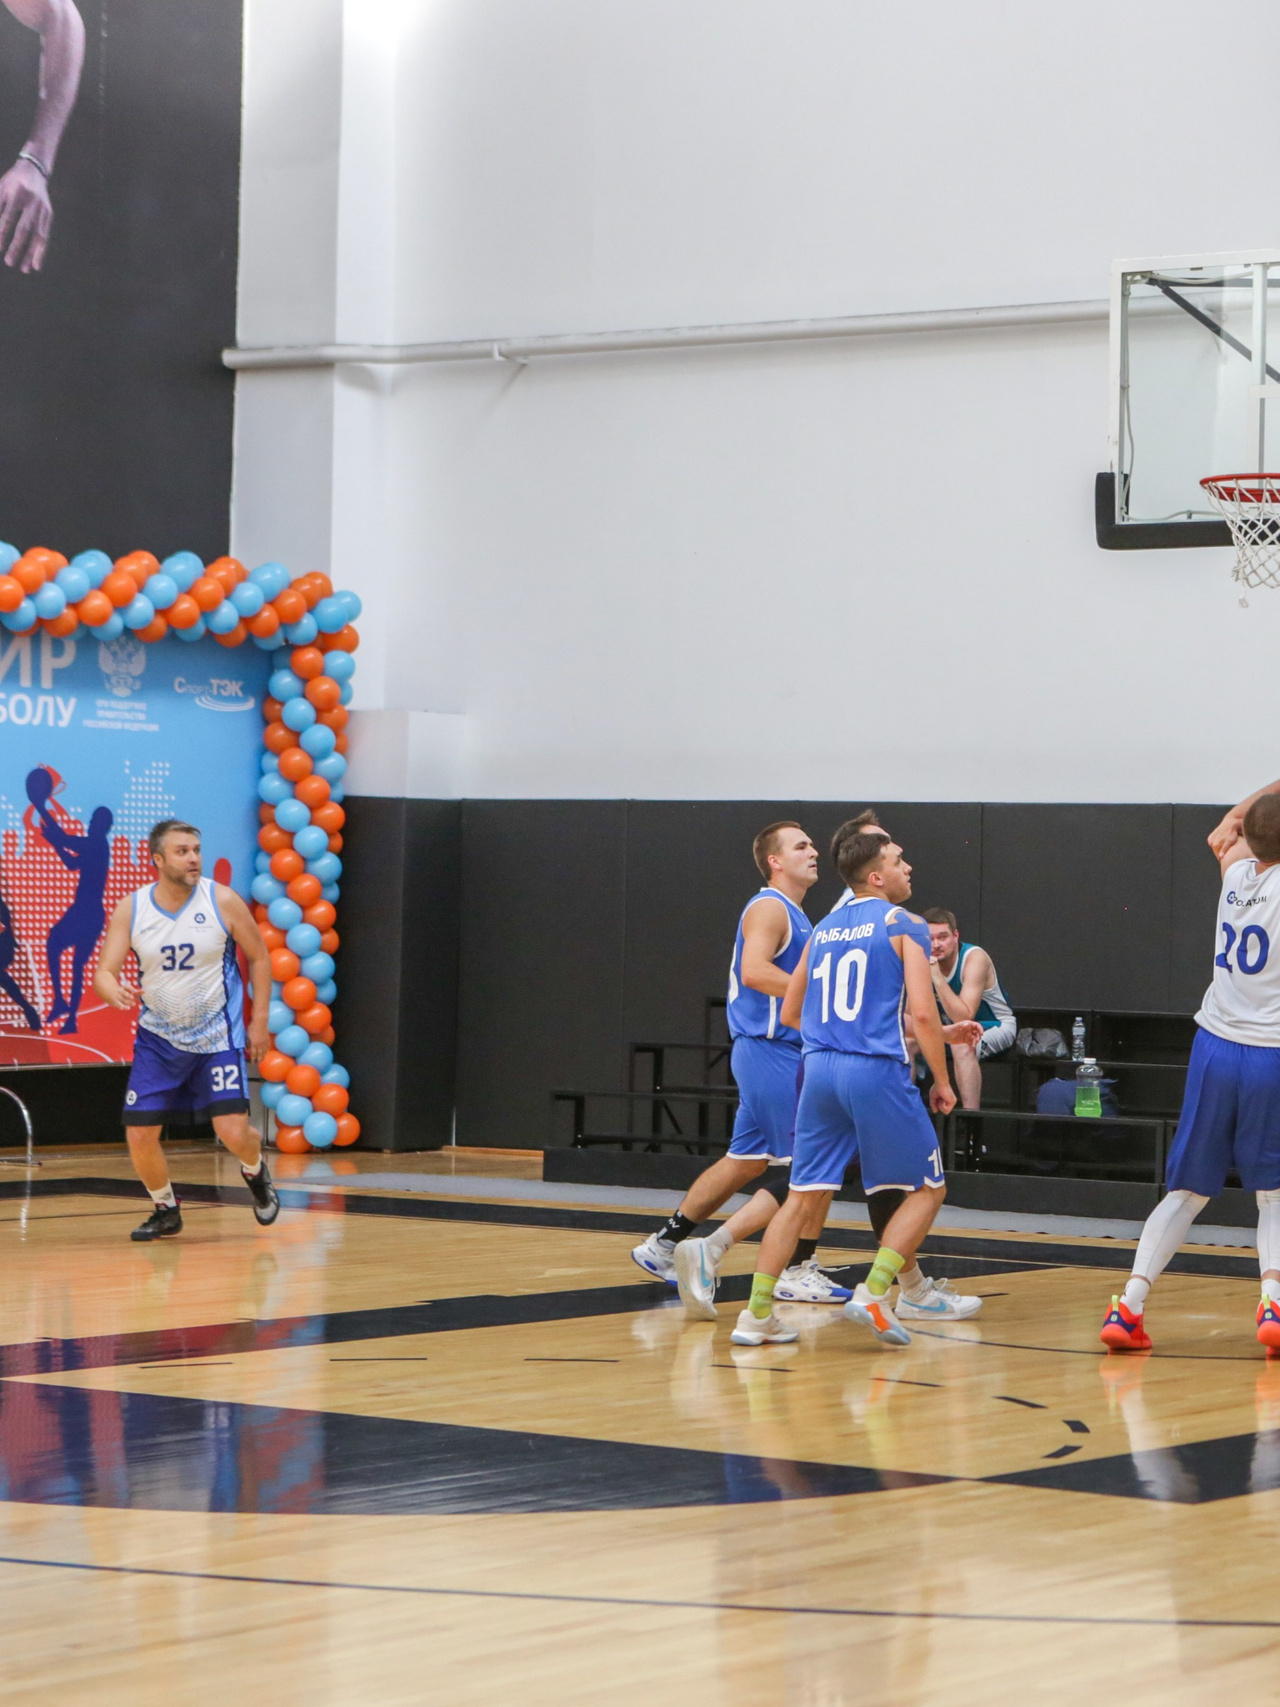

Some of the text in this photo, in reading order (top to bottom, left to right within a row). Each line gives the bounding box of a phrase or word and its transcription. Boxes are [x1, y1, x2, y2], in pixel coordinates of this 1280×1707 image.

[814, 922, 875, 947] РЫБАЛОВ
[1215, 921, 1270, 976] 20
[160, 943, 196, 972] 32
[812, 948, 868, 1024] 10
[211, 1064, 241, 1092] 32
